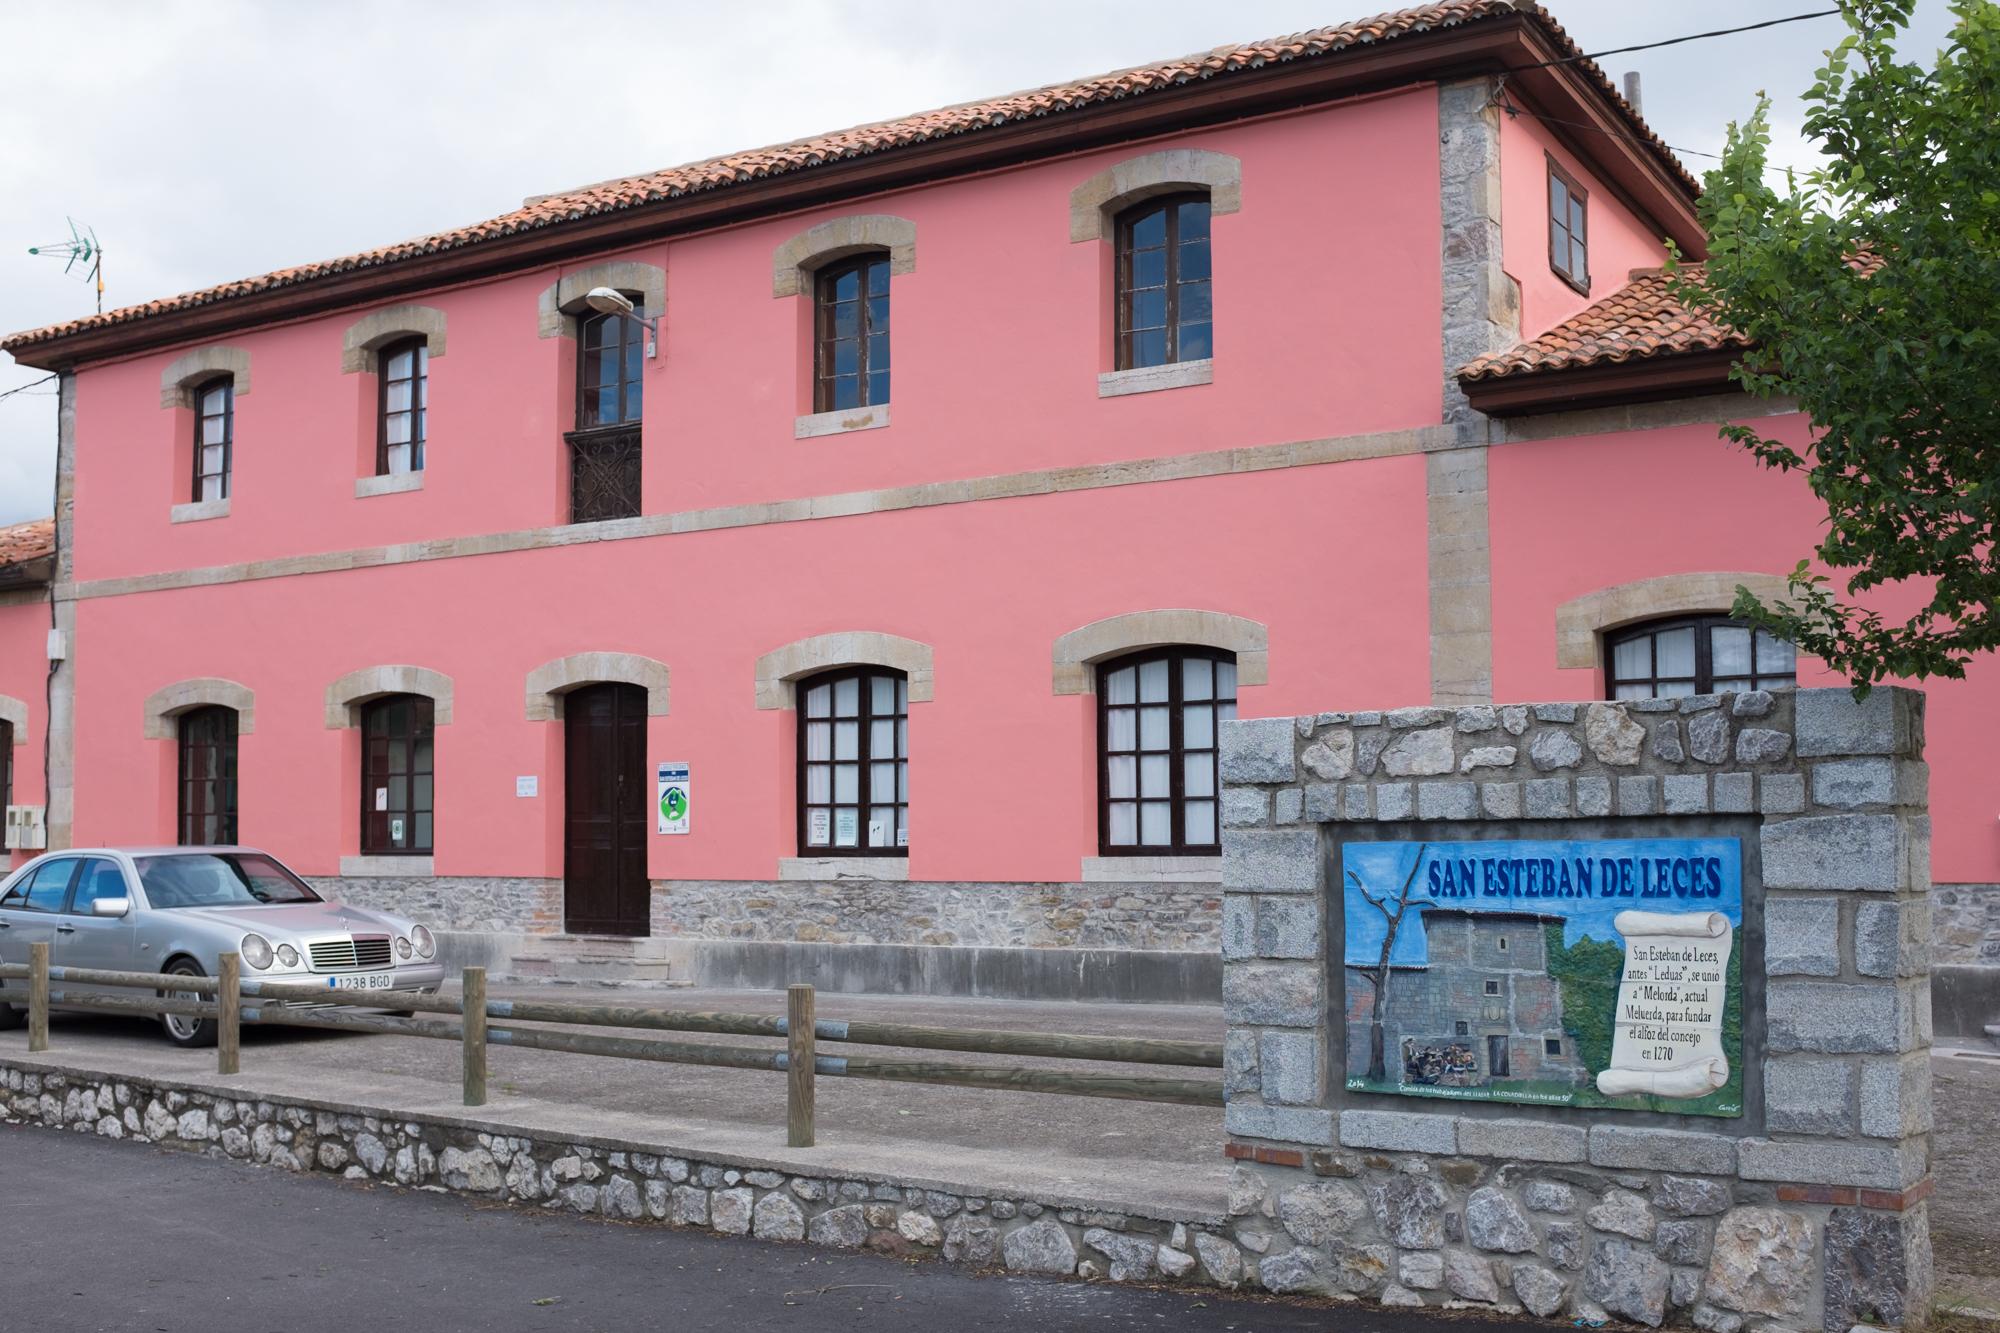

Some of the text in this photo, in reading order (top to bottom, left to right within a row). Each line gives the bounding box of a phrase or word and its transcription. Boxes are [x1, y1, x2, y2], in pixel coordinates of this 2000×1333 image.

[1428, 856, 1721, 898] SAN ESTEBAN DE LECES
[1633, 946, 1719, 964] San Esteban de Leces,
[370, 975, 389, 988] BGD
[1628, 969, 1648, 980] antes
[1691, 972, 1700, 982] se
[1632, 989, 1638, 999] a
[1684, 988, 1708, 1003] actual
[1625, 1004, 1712, 1025] Meluerda, para fundar
[1629, 1025, 1701, 1048] el alfoz del concejo
[1641, 1046, 1674, 1061] en 1270
